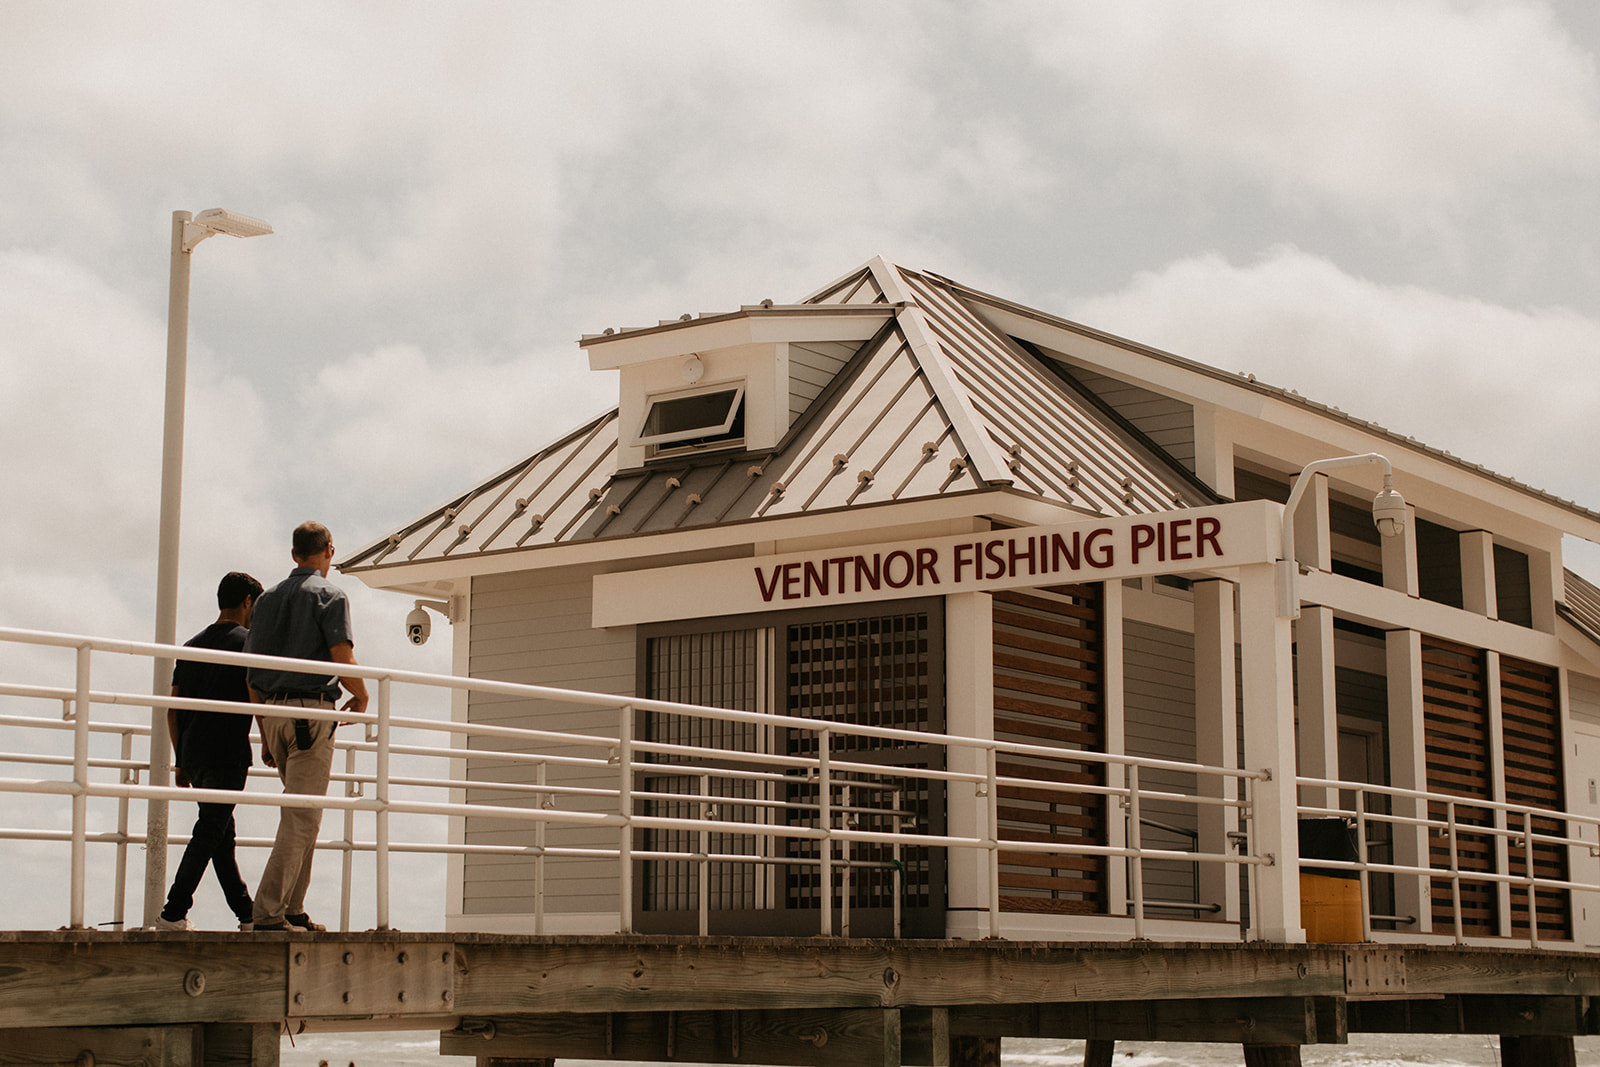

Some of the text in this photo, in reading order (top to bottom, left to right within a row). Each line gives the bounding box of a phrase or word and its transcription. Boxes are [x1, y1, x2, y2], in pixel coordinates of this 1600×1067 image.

[754, 517, 1224, 602] VENTNOR FISHING PIER
